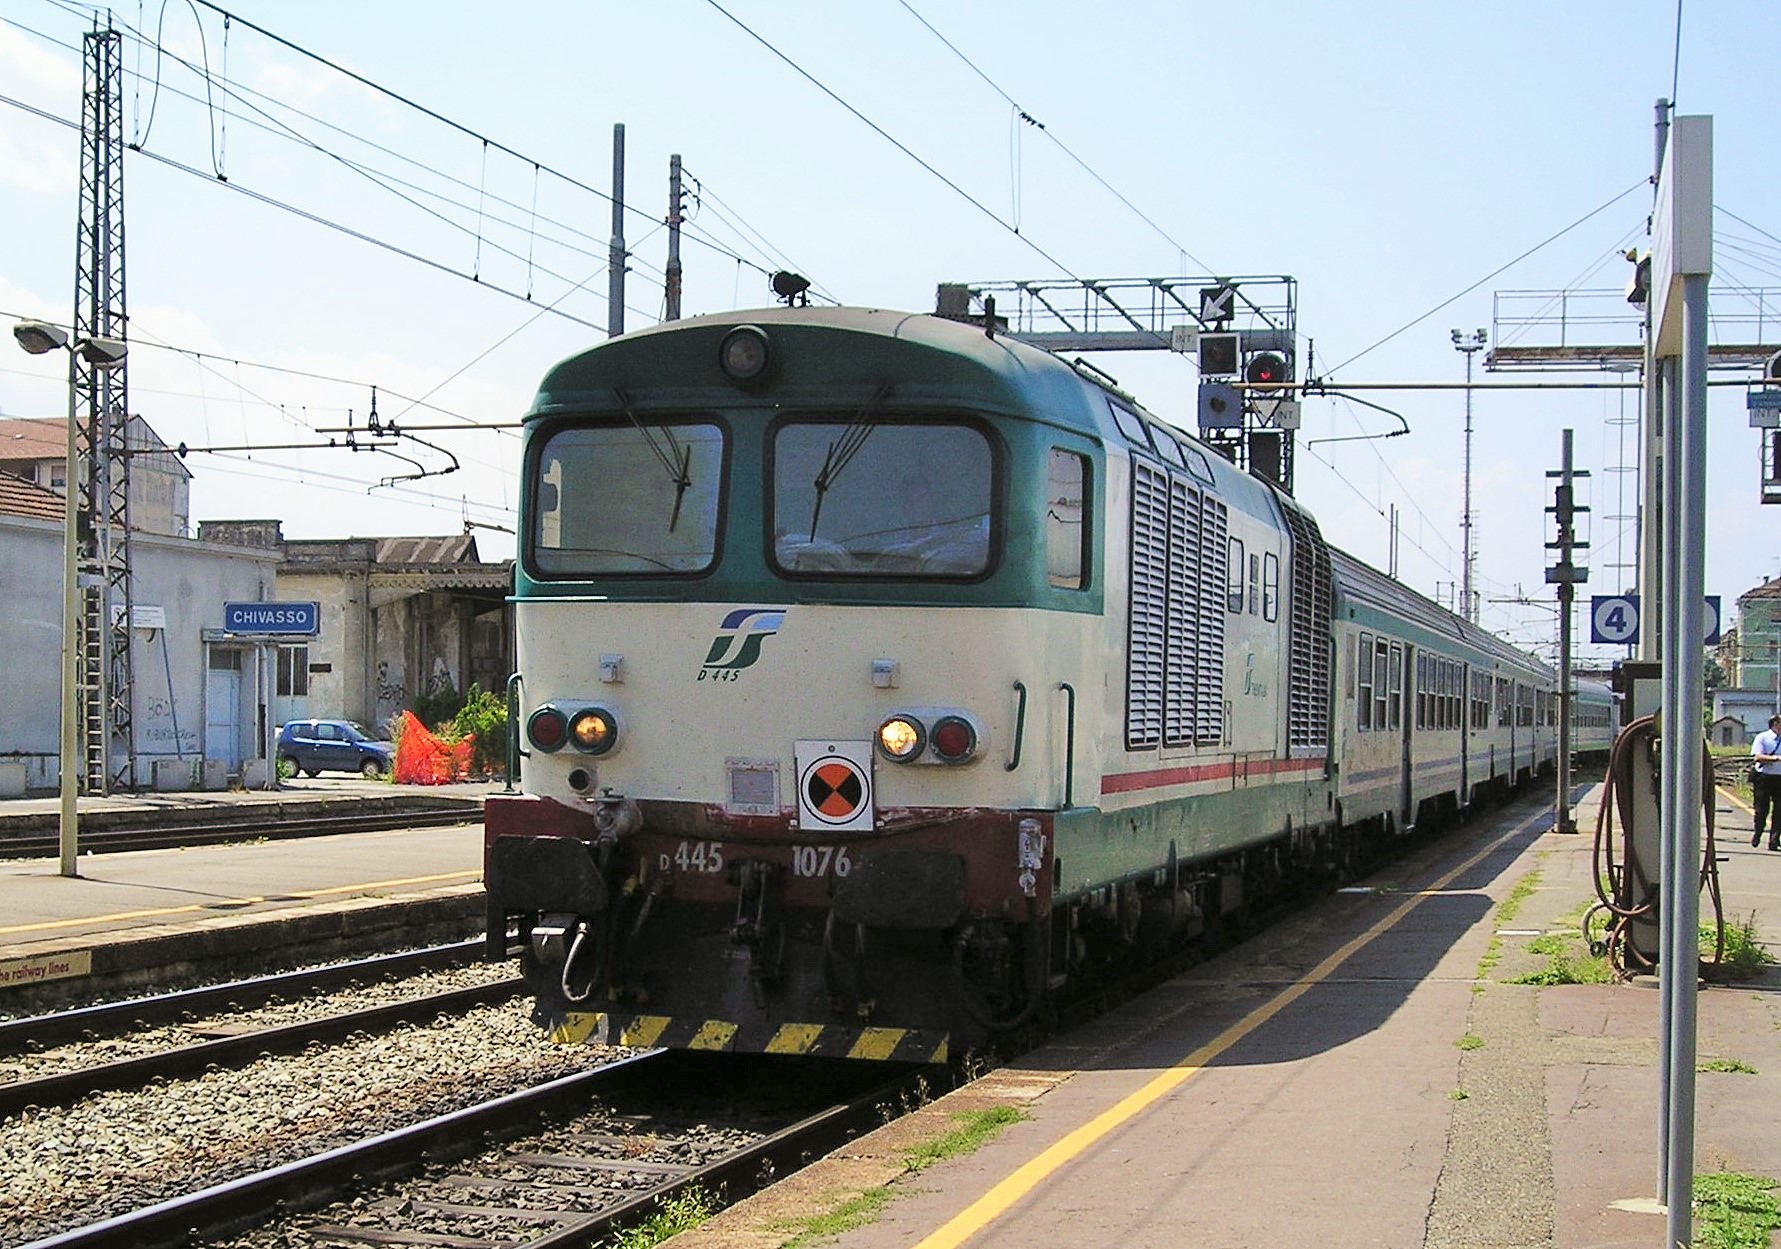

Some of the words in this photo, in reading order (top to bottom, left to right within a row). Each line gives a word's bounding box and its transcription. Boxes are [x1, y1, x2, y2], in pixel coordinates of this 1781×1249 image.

[233, 610, 307, 624] CHIVASSO
[1604, 606, 1627, 633] 4
[712, 670, 740, 682] 445
[659, 854, 670, 871] D
[674, 841, 724, 873] 445
[791, 846, 851, 878] 1076
[12, 964, 47, 979] railway
[48, 961, 70, 974] lines
